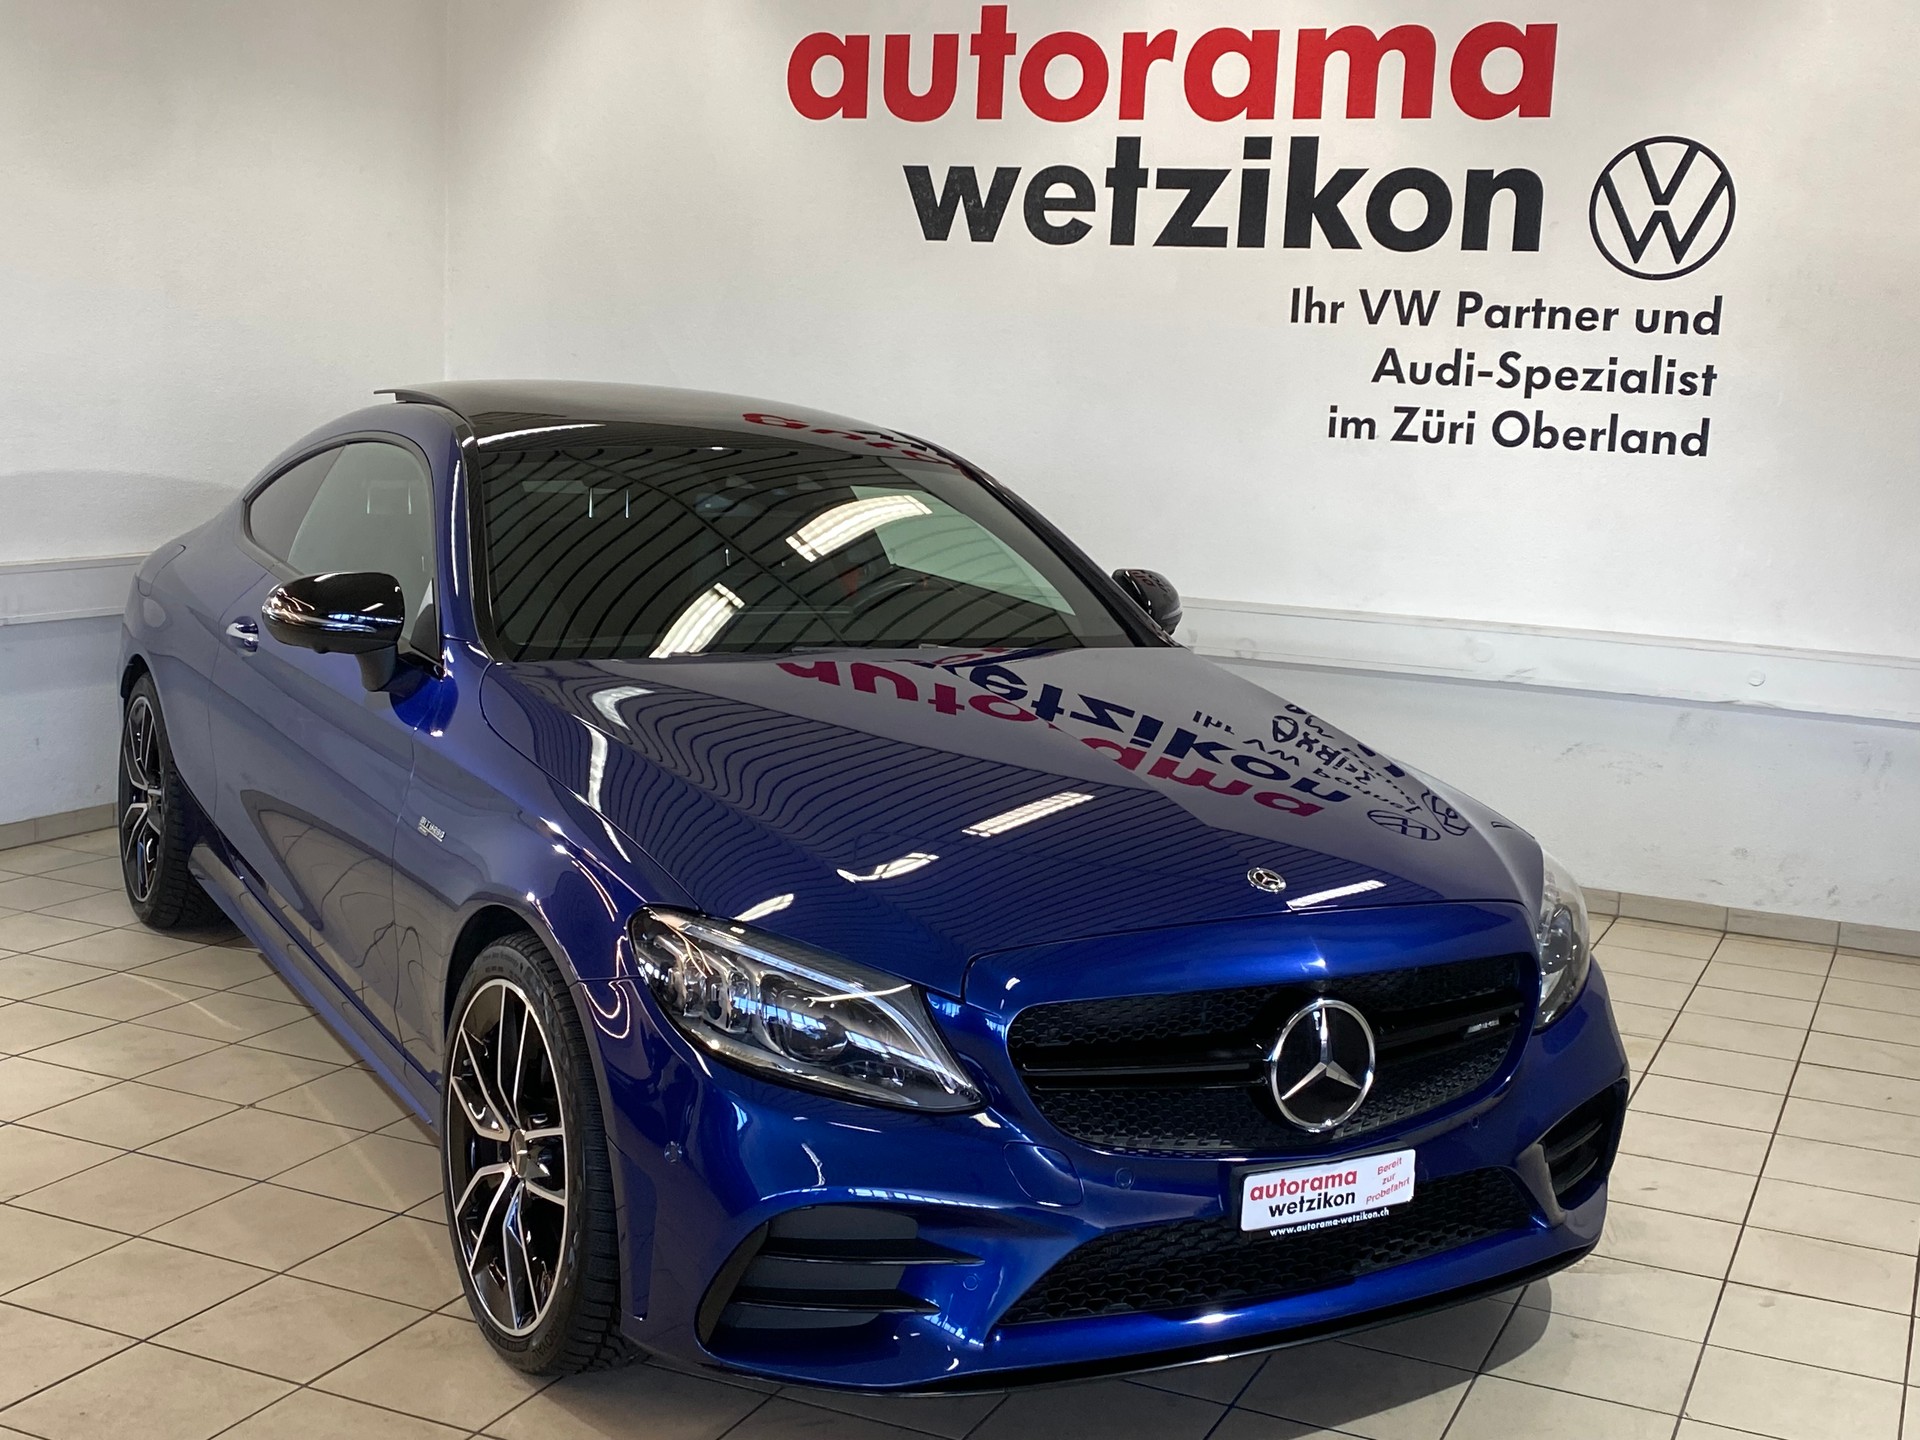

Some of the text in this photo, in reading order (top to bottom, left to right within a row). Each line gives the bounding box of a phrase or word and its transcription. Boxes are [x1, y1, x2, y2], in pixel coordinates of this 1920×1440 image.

[787, 4, 1557, 123] autorama
[903, 135, 1544, 253] wetzikon
[1290, 286, 1723, 336] Ihr VW Partner und
[1371, 347, 1718, 399] Audi-Spezialist
[1328, 405, 1711, 457] im Züri Oberland
[1377, 1157, 1403, 1176] Bereit
[1382, 1172, 1397, 1186] zur
[1250, 1170, 1358, 1201] autorama
[1365, 1176, 1411, 1205] Probefahrt
[1268, 1191, 1356, 1218] wetzikon
[1269, 1207, 1390, 1237] www.autorama-wetzikon.ch
